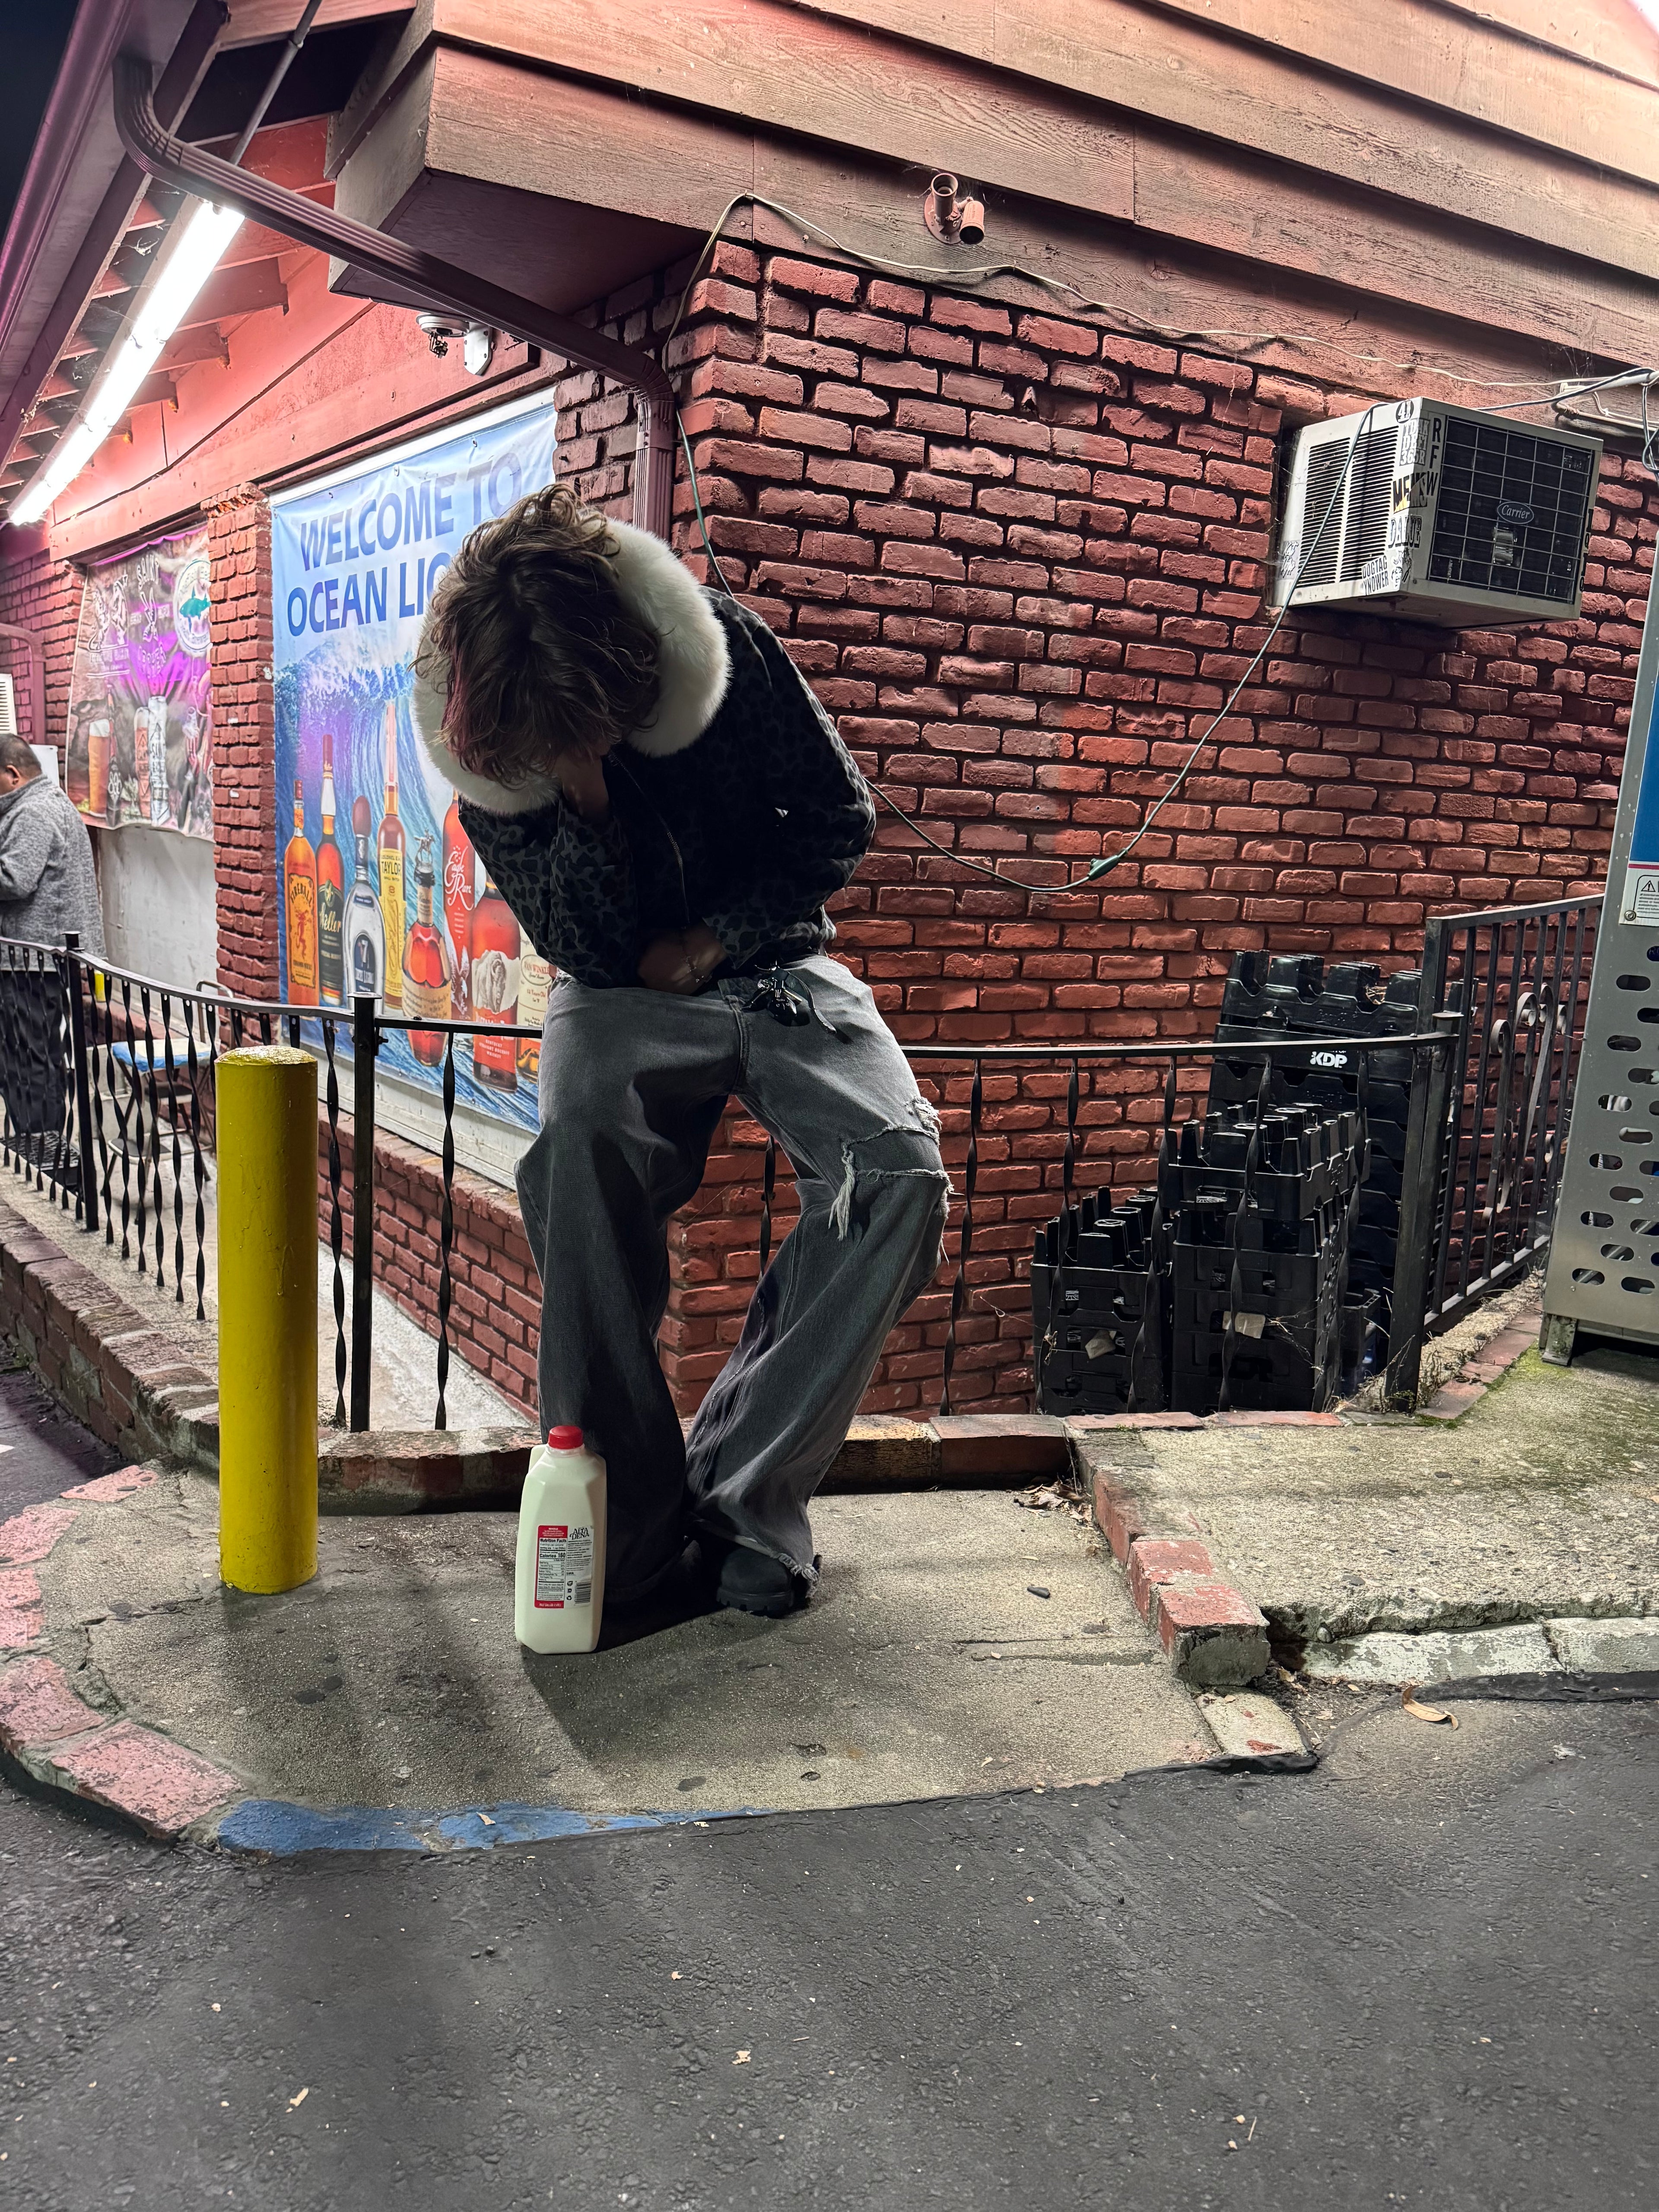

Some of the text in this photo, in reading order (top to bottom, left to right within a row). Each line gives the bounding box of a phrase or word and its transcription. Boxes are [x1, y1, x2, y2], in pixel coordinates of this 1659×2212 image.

[300, 452, 522, 571] WELCOME TO
[1501, 505, 1530, 519] Carrier
[287, 566, 388, 637] OCEAN
[381, 861, 401, 876] TAYLOR
[444, 846, 468, 894] Eagle
[290, 883, 312, 907] FIREBALL
[448, 872, 474, 911] Rare
[319, 902, 341, 932] Weller
[569, 1532, 589, 1540] DENA
